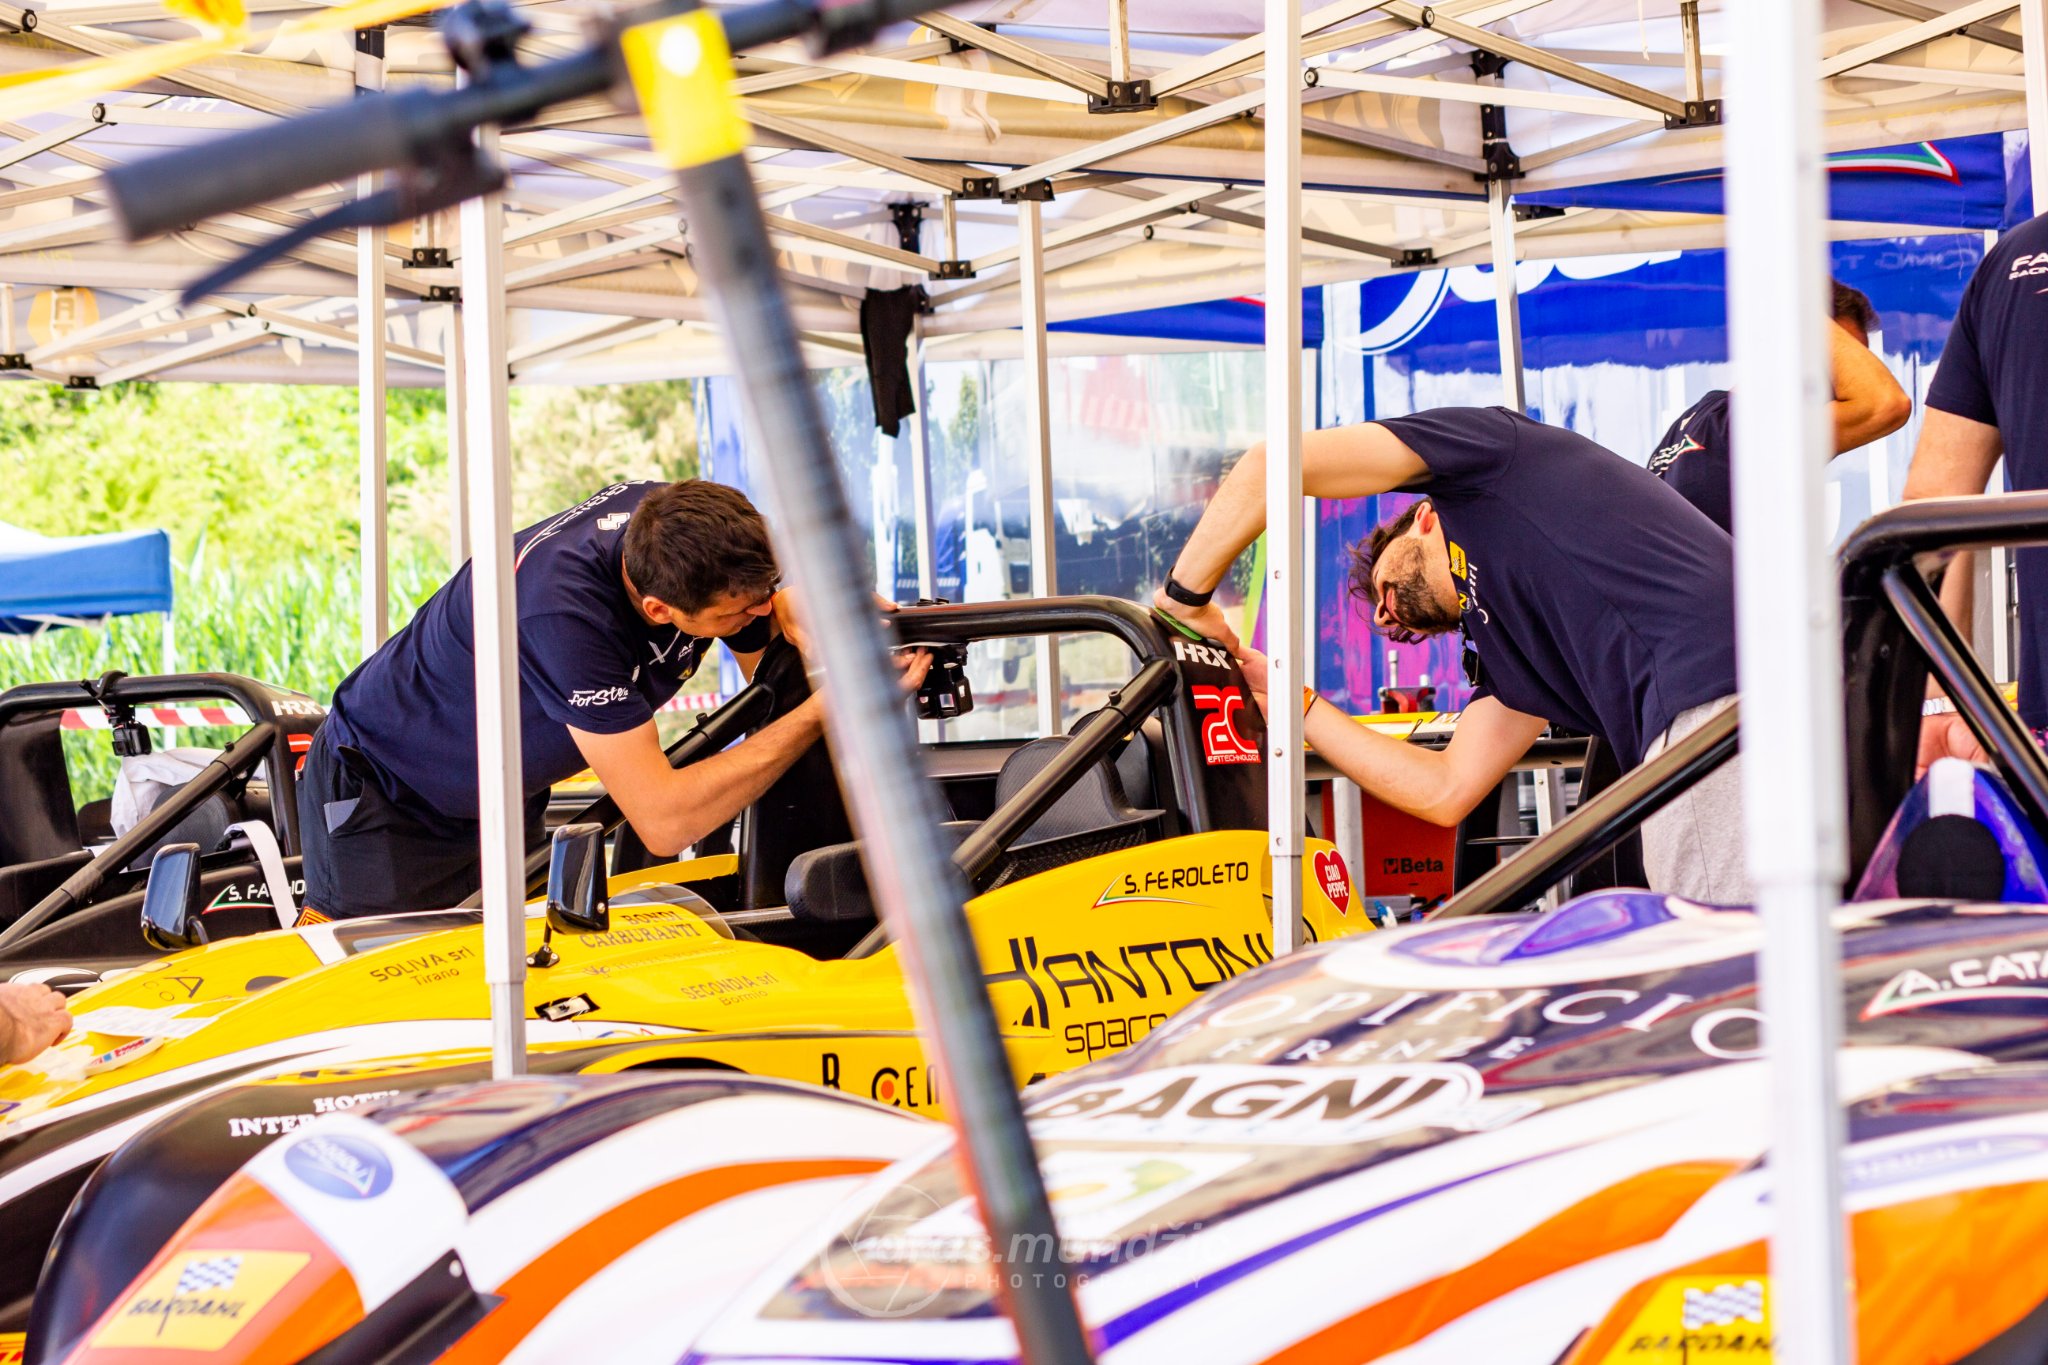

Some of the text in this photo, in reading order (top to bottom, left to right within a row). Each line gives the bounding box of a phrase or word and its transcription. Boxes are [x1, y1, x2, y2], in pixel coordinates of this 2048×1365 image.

[1173, 641, 1232, 670] HRX
[270, 700, 323, 716] HRX
[1324, 864, 1341, 882] CIAO
[1400, 857, 1444, 874] Beta
[1124, 861, 1249, 895] S. FEROLETO
[1326, 881, 1349, 899] PEPPE
[228, 885, 243, 902] S.
[579, 923, 703, 949] CARBURANTI
[369, 946, 473, 983] SOLIVA srl
[412, 967, 461, 986] Tirano
[680, 975, 758, 1001] SECONDIA
[720, 990, 769, 1008] Bormio
[1207, 988, 1772, 1060] OPIFICIO
[312, 1089, 400, 1113] HOTE
[1027, 1076, 1449, 1121] BAGNI
